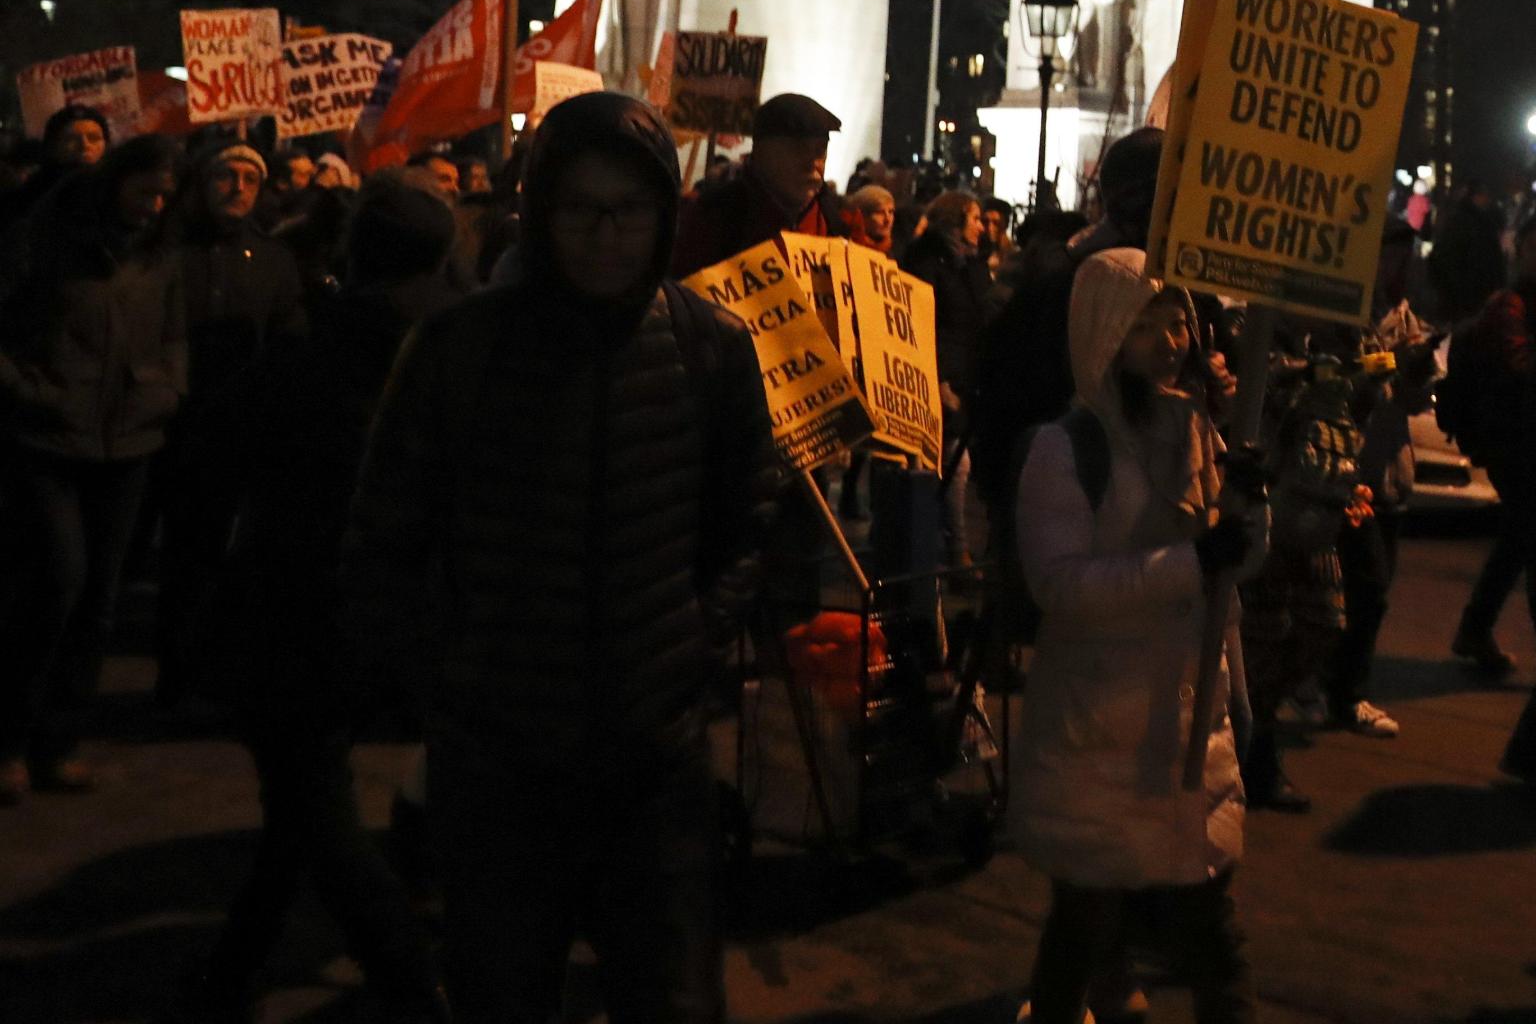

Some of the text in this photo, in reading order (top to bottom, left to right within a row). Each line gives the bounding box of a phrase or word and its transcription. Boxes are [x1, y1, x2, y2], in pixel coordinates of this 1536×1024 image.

[1230, 28, 1381, 109] UNITE TO
[1230, 80, 1362, 153] DEFEND
[1200, 141, 1372, 225] WOMEN'S
[1206, 196, 1349, 268] RIGHTS!
[706, 256, 785, 305] MÁS
[763, 350, 826, 391] TRA
[883, 351, 929, 407] LGBTQ
